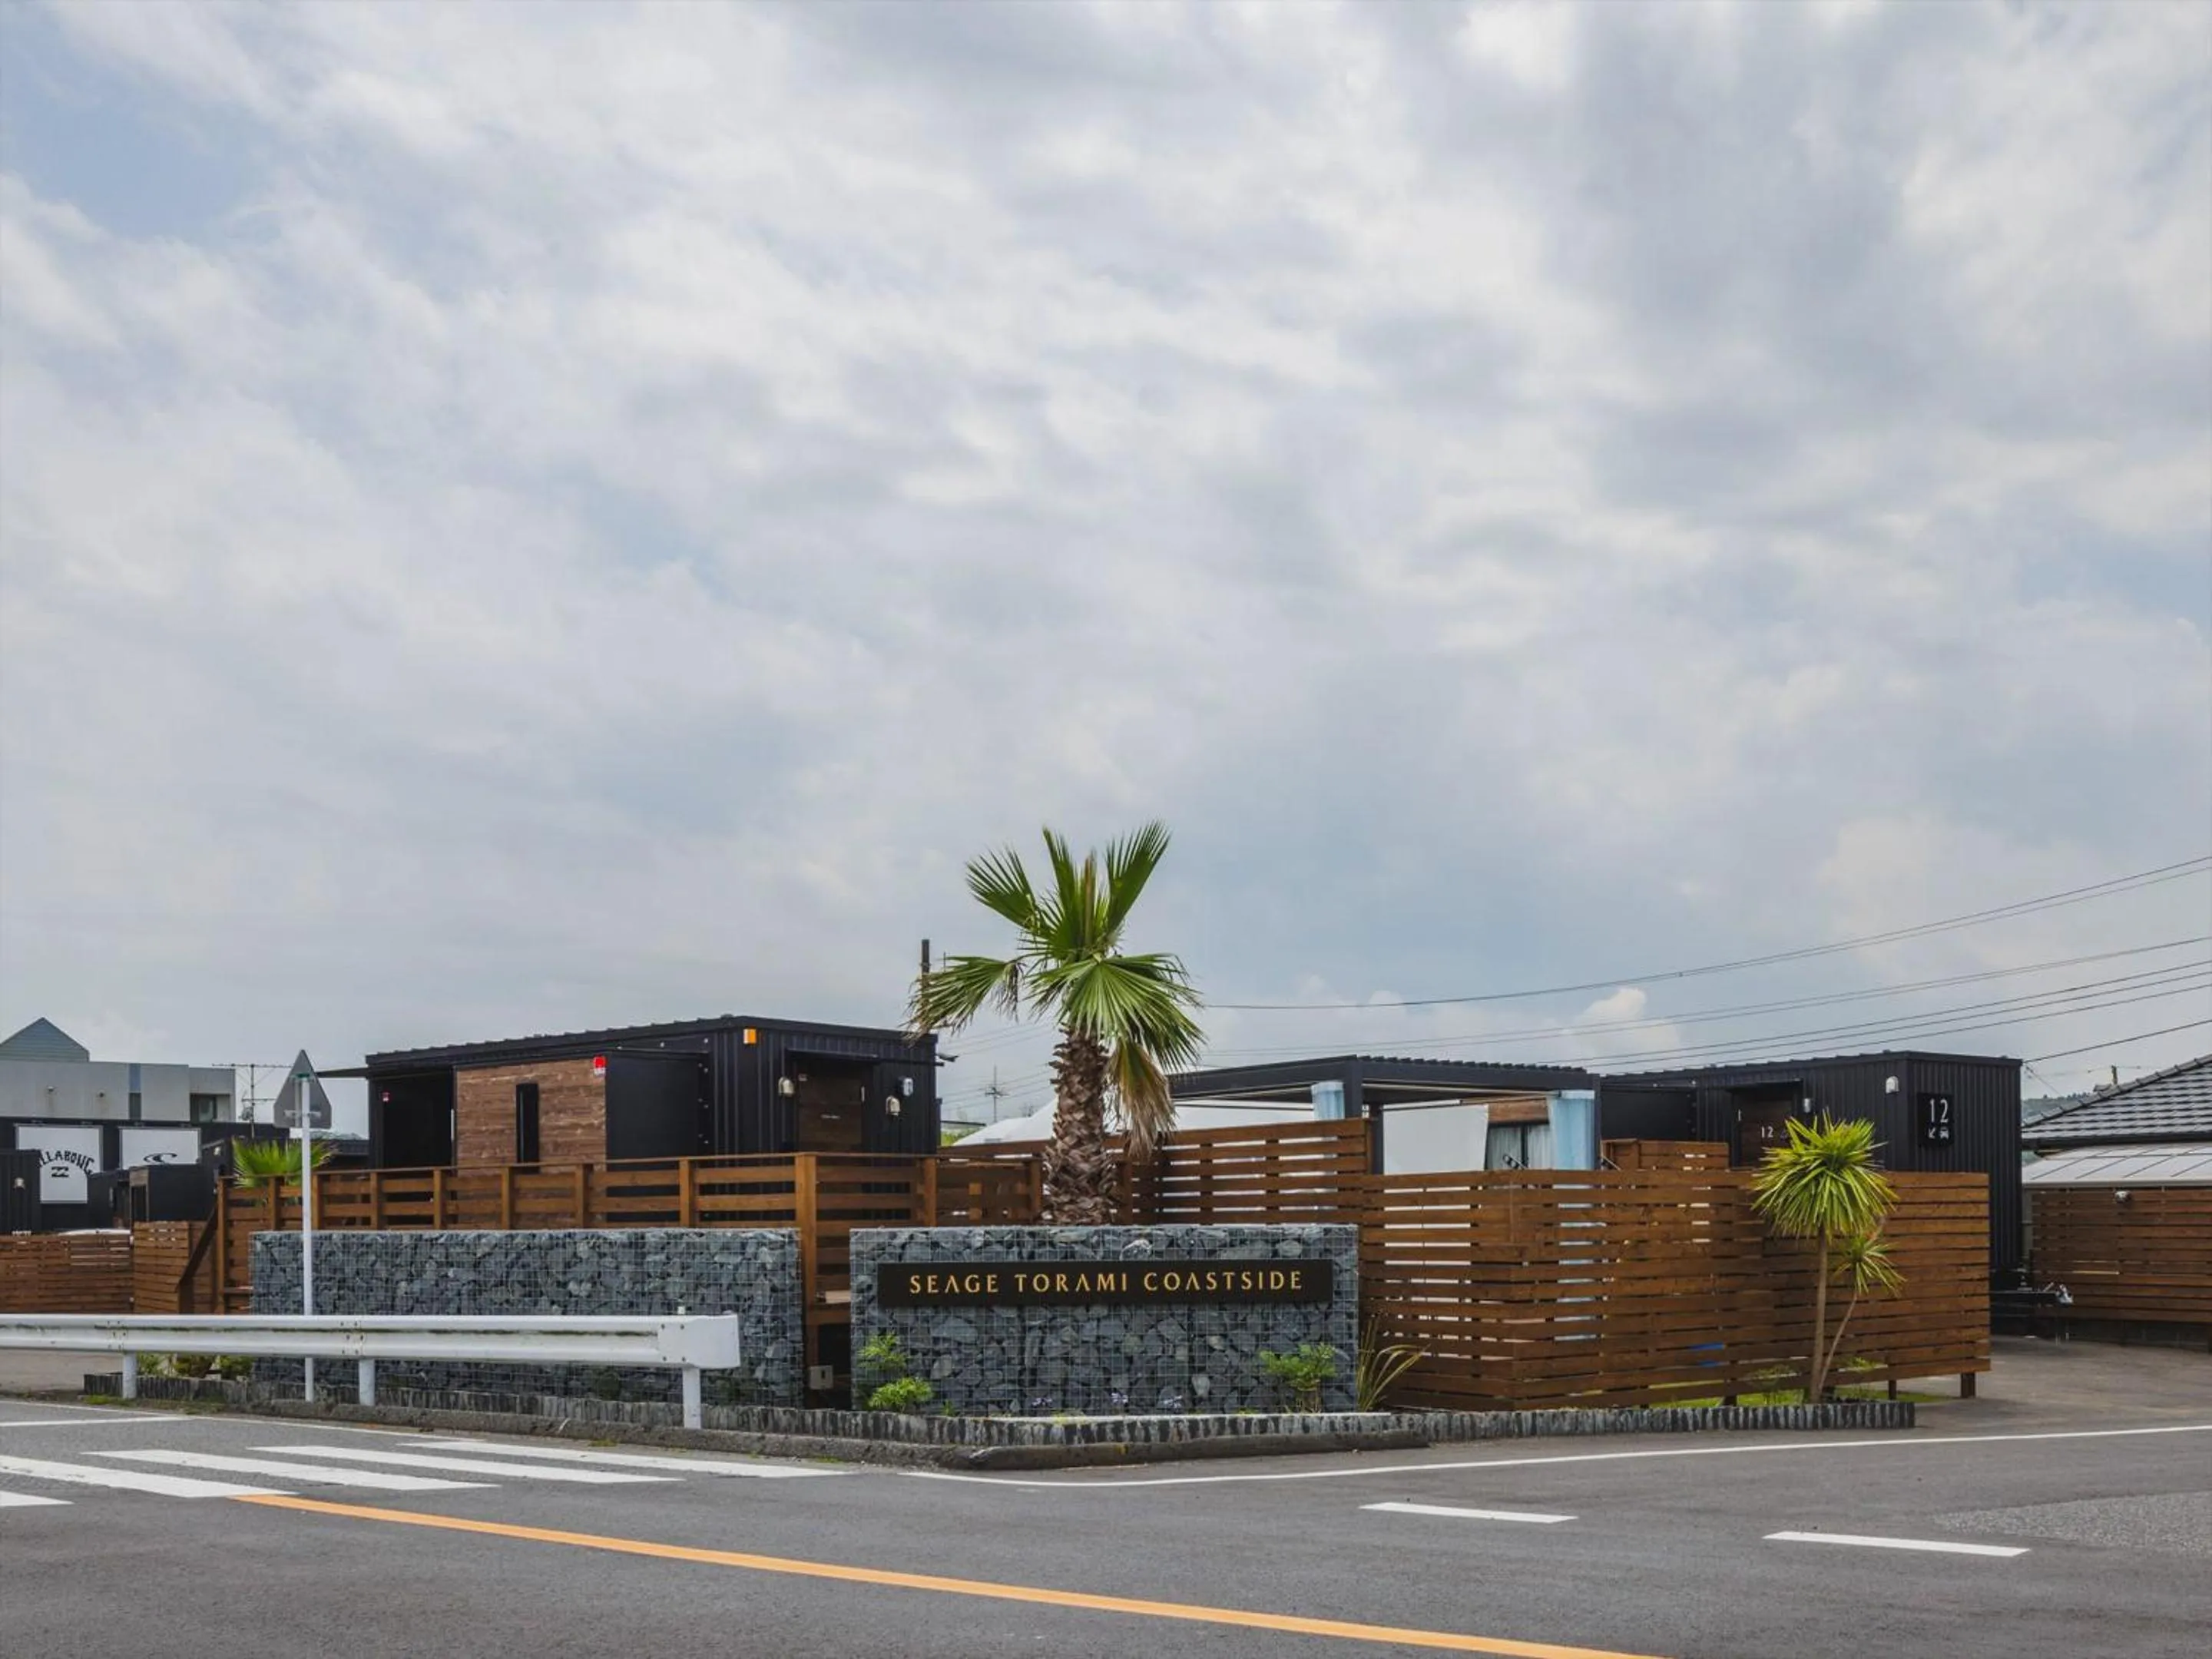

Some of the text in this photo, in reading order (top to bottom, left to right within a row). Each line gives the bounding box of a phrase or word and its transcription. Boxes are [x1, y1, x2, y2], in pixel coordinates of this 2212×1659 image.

[1929, 1098, 1949, 1123] 12
[1761, 1126, 1773, 1138] 12
[909, 1270, 1303, 1293] SEAGE TORAMI COASTSIDE
